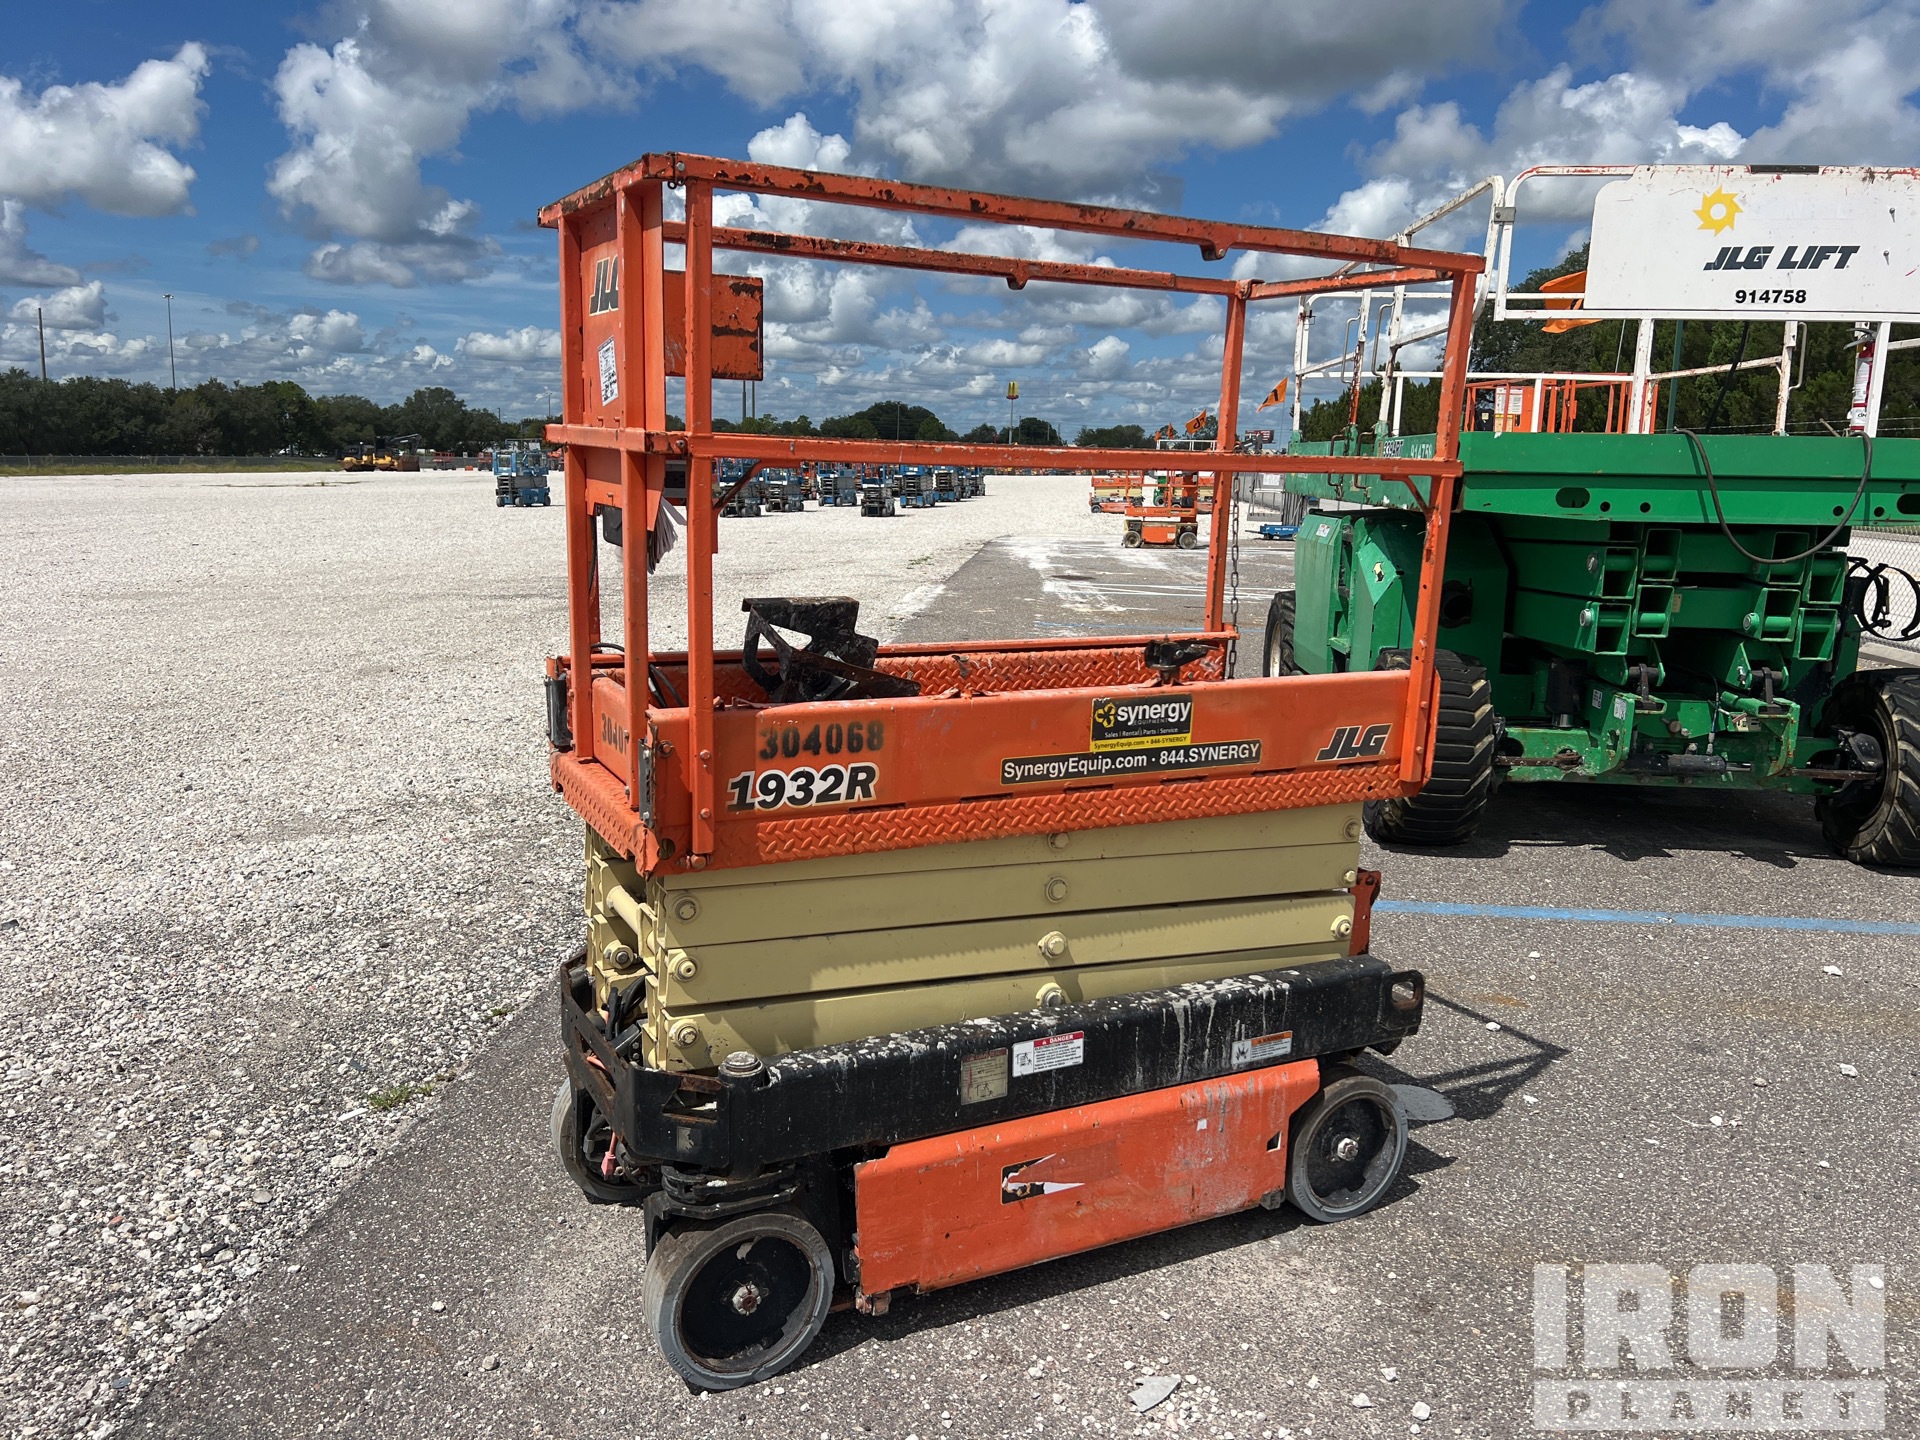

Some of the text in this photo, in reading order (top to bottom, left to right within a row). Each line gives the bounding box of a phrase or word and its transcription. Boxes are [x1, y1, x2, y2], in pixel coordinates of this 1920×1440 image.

[1703, 246, 1861, 270] JLG LIFT
[1735, 289, 1807, 304] 914758
[1116, 702, 1192, 726] synergy
[758, 720, 885, 760] 304068
[1094, 736, 1187, 750] SynergyEquip.com 844-SYNERGY
[1315, 723, 1393, 762] JLG
[1003, 743, 1260, 780] SynergyEquip.com 844.SYNERGY
[726, 763, 880, 814] 1932R
[1049, 1034, 1074, 1043] DANGER
